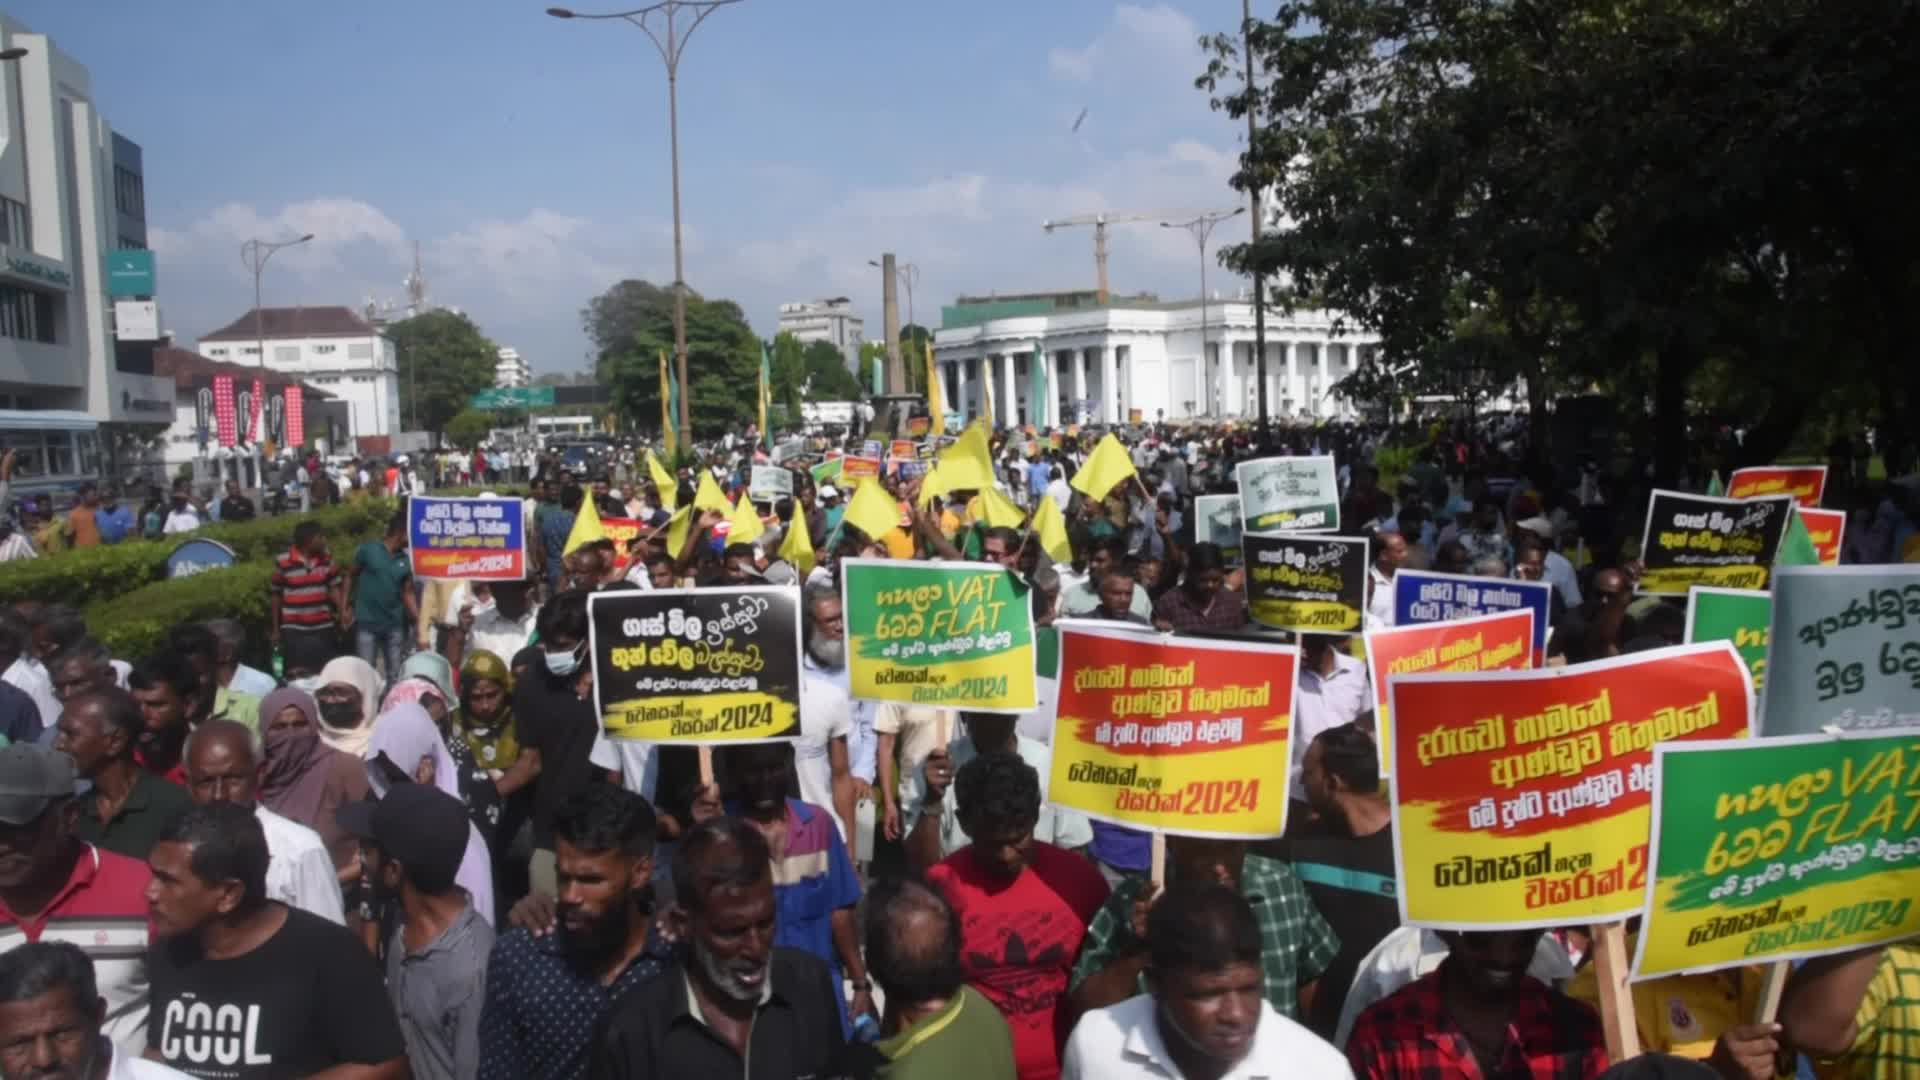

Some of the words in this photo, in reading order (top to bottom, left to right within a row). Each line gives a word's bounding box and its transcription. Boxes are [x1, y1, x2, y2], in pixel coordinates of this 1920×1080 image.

[948, 573, 1001, 606] VAT
[668, 608, 702, 640] මිල
[929, 602, 1006, 638] FLAT
[1312, 610, 1346, 625] 2024
[611, 642, 646, 671] තුන්
[650, 639, 694, 670] වේල
[960, 675, 1008, 700] 2024
[1111, 689, 1182, 718] ආණ්ඩුව
[720, 702, 773, 732] 2024
[1490, 732, 1604, 788] ආණ්ඩුව
[1184, 778, 1260, 815] 2024
[1547, 769, 1625, 818] ආණ්ඩුව
[1434, 842, 1552, 889] වෙනසක්
[1525, 860, 1624, 910] වසරක්
[1824, 898, 1912, 939] 2024
[161, 999, 272, 1065] COOL
